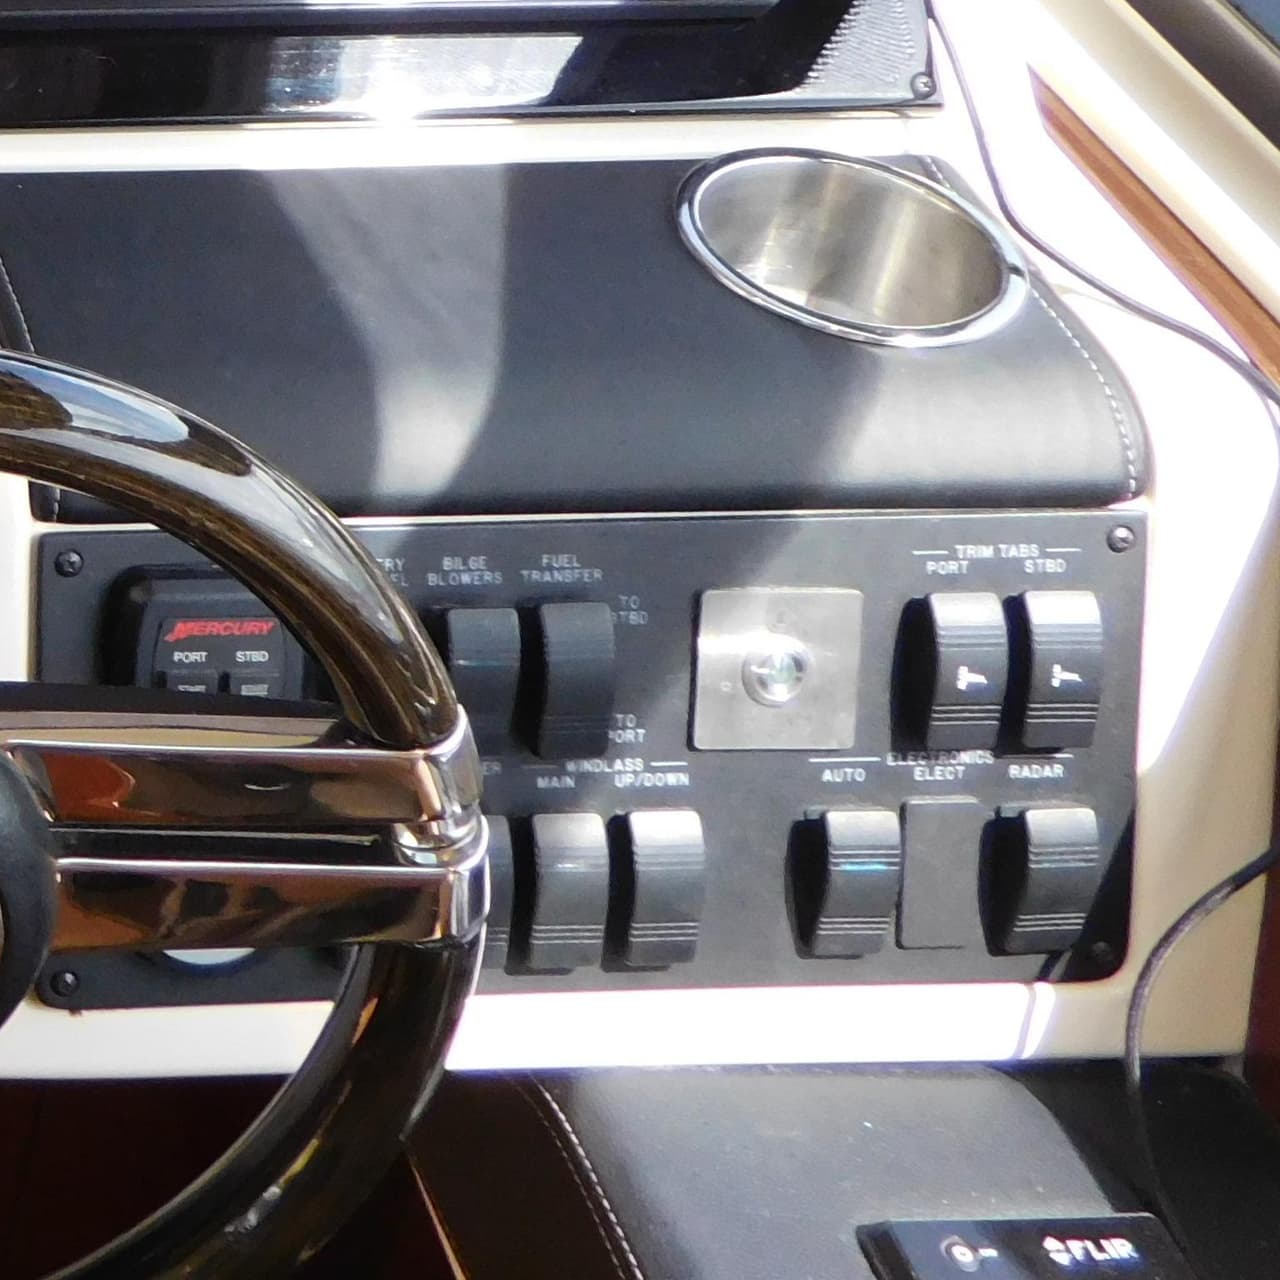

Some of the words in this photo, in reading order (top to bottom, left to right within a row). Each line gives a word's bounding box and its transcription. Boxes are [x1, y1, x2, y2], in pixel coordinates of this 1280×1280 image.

[955, 544, 995, 559] TRIM
[998, 543, 1040, 558] TABS
[443, 555, 488, 571] BILGE
[542, 554, 582, 569] FUEL
[926, 560, 969, 575] PORT
[1024, 558, 1067, 574] STBD
[427, 571, 503, 587] BLOWERS
[521, 569, 603, 584] TRANSFER
[618, 595, 640, 609] TO
[165, 620, 276, 642] MERCURY
[173, 651, 208, 663] PORT
[235, 650, 270, 662] STBD
[615, 714, 636, 728] TO
[564, 758, 644, 773] WINDLASS
[886, 750, 995, 768] ELECTRONICS
[821, 768, 866, 783] AUTO
[913, 765, 966, 781] ELECT
[1008, 764, 1065, 779] RADAR
[536, 775, 576, 789] MAIN
[614, 772, 690, 788] UP/DOWN
[1066, 1237, 1139, 1262] FLIR
